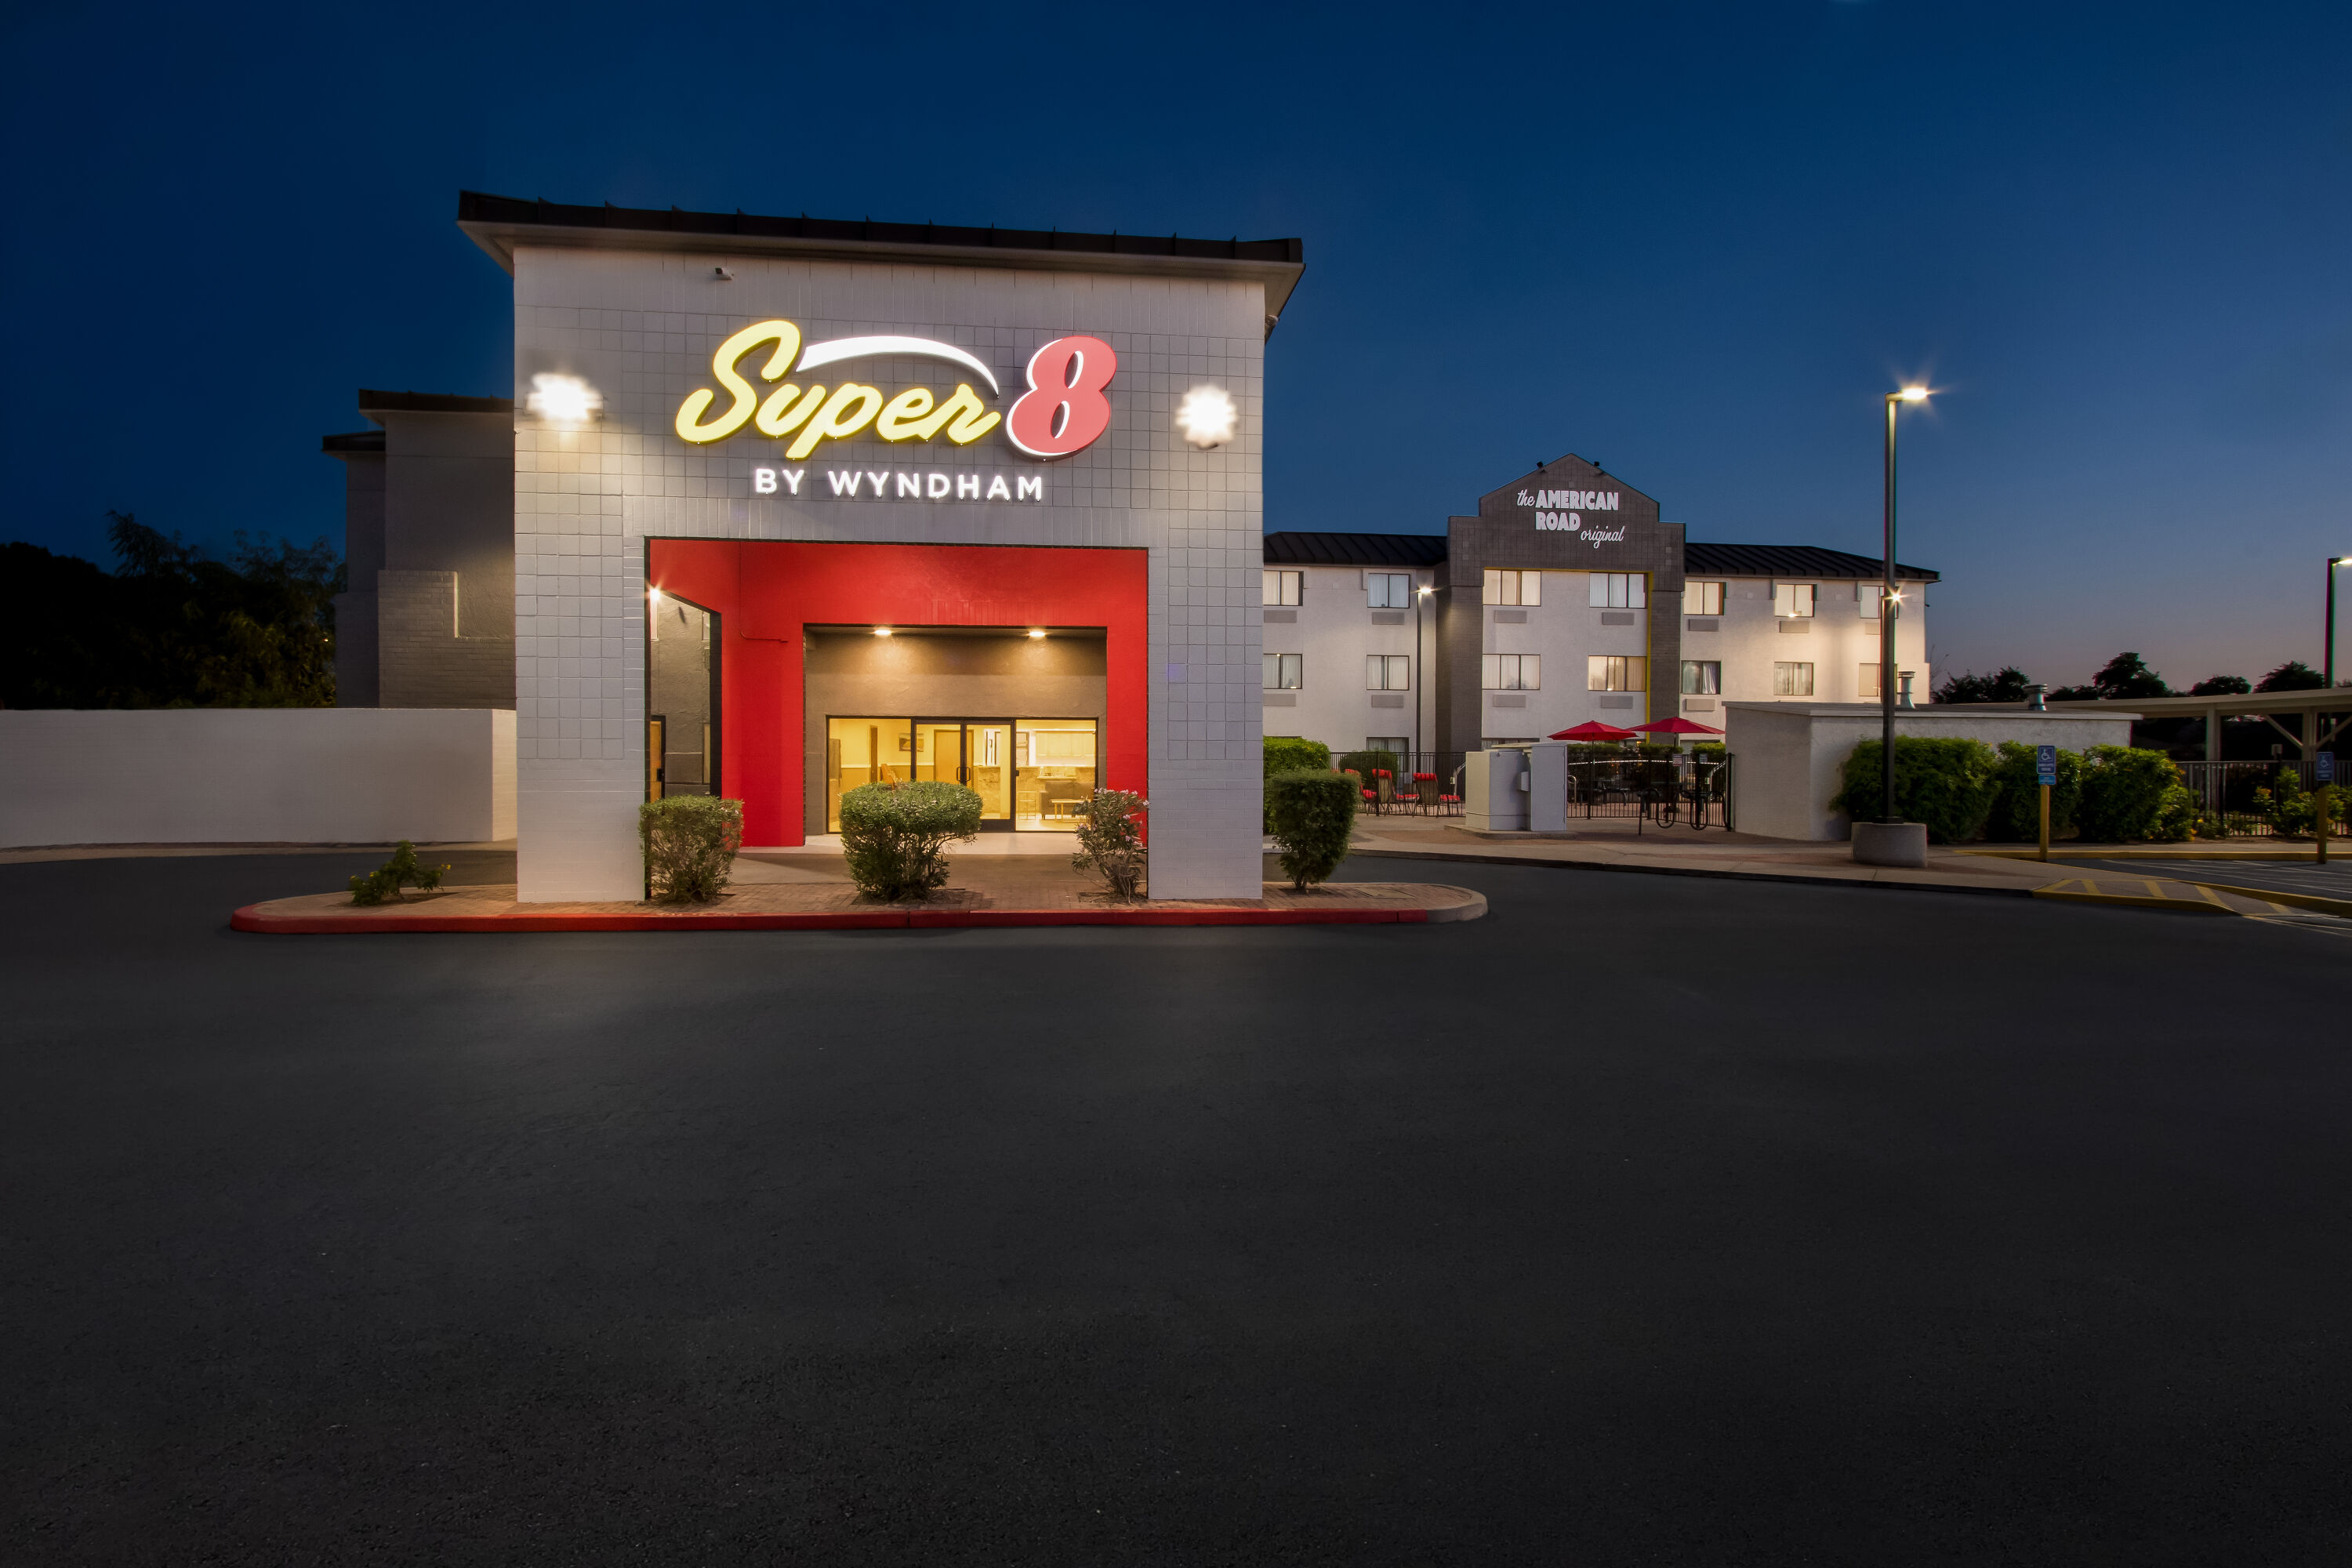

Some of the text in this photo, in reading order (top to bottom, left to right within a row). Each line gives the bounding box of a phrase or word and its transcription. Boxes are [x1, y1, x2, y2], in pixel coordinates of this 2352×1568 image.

[675, 320, 1117, 460] Super 8
[755, 468, 1043, 502] BY WYNDHAM
[1517, 489, 1619, 510] the AMERICAN
[1535, 511, 1625, 549] ROAD original
